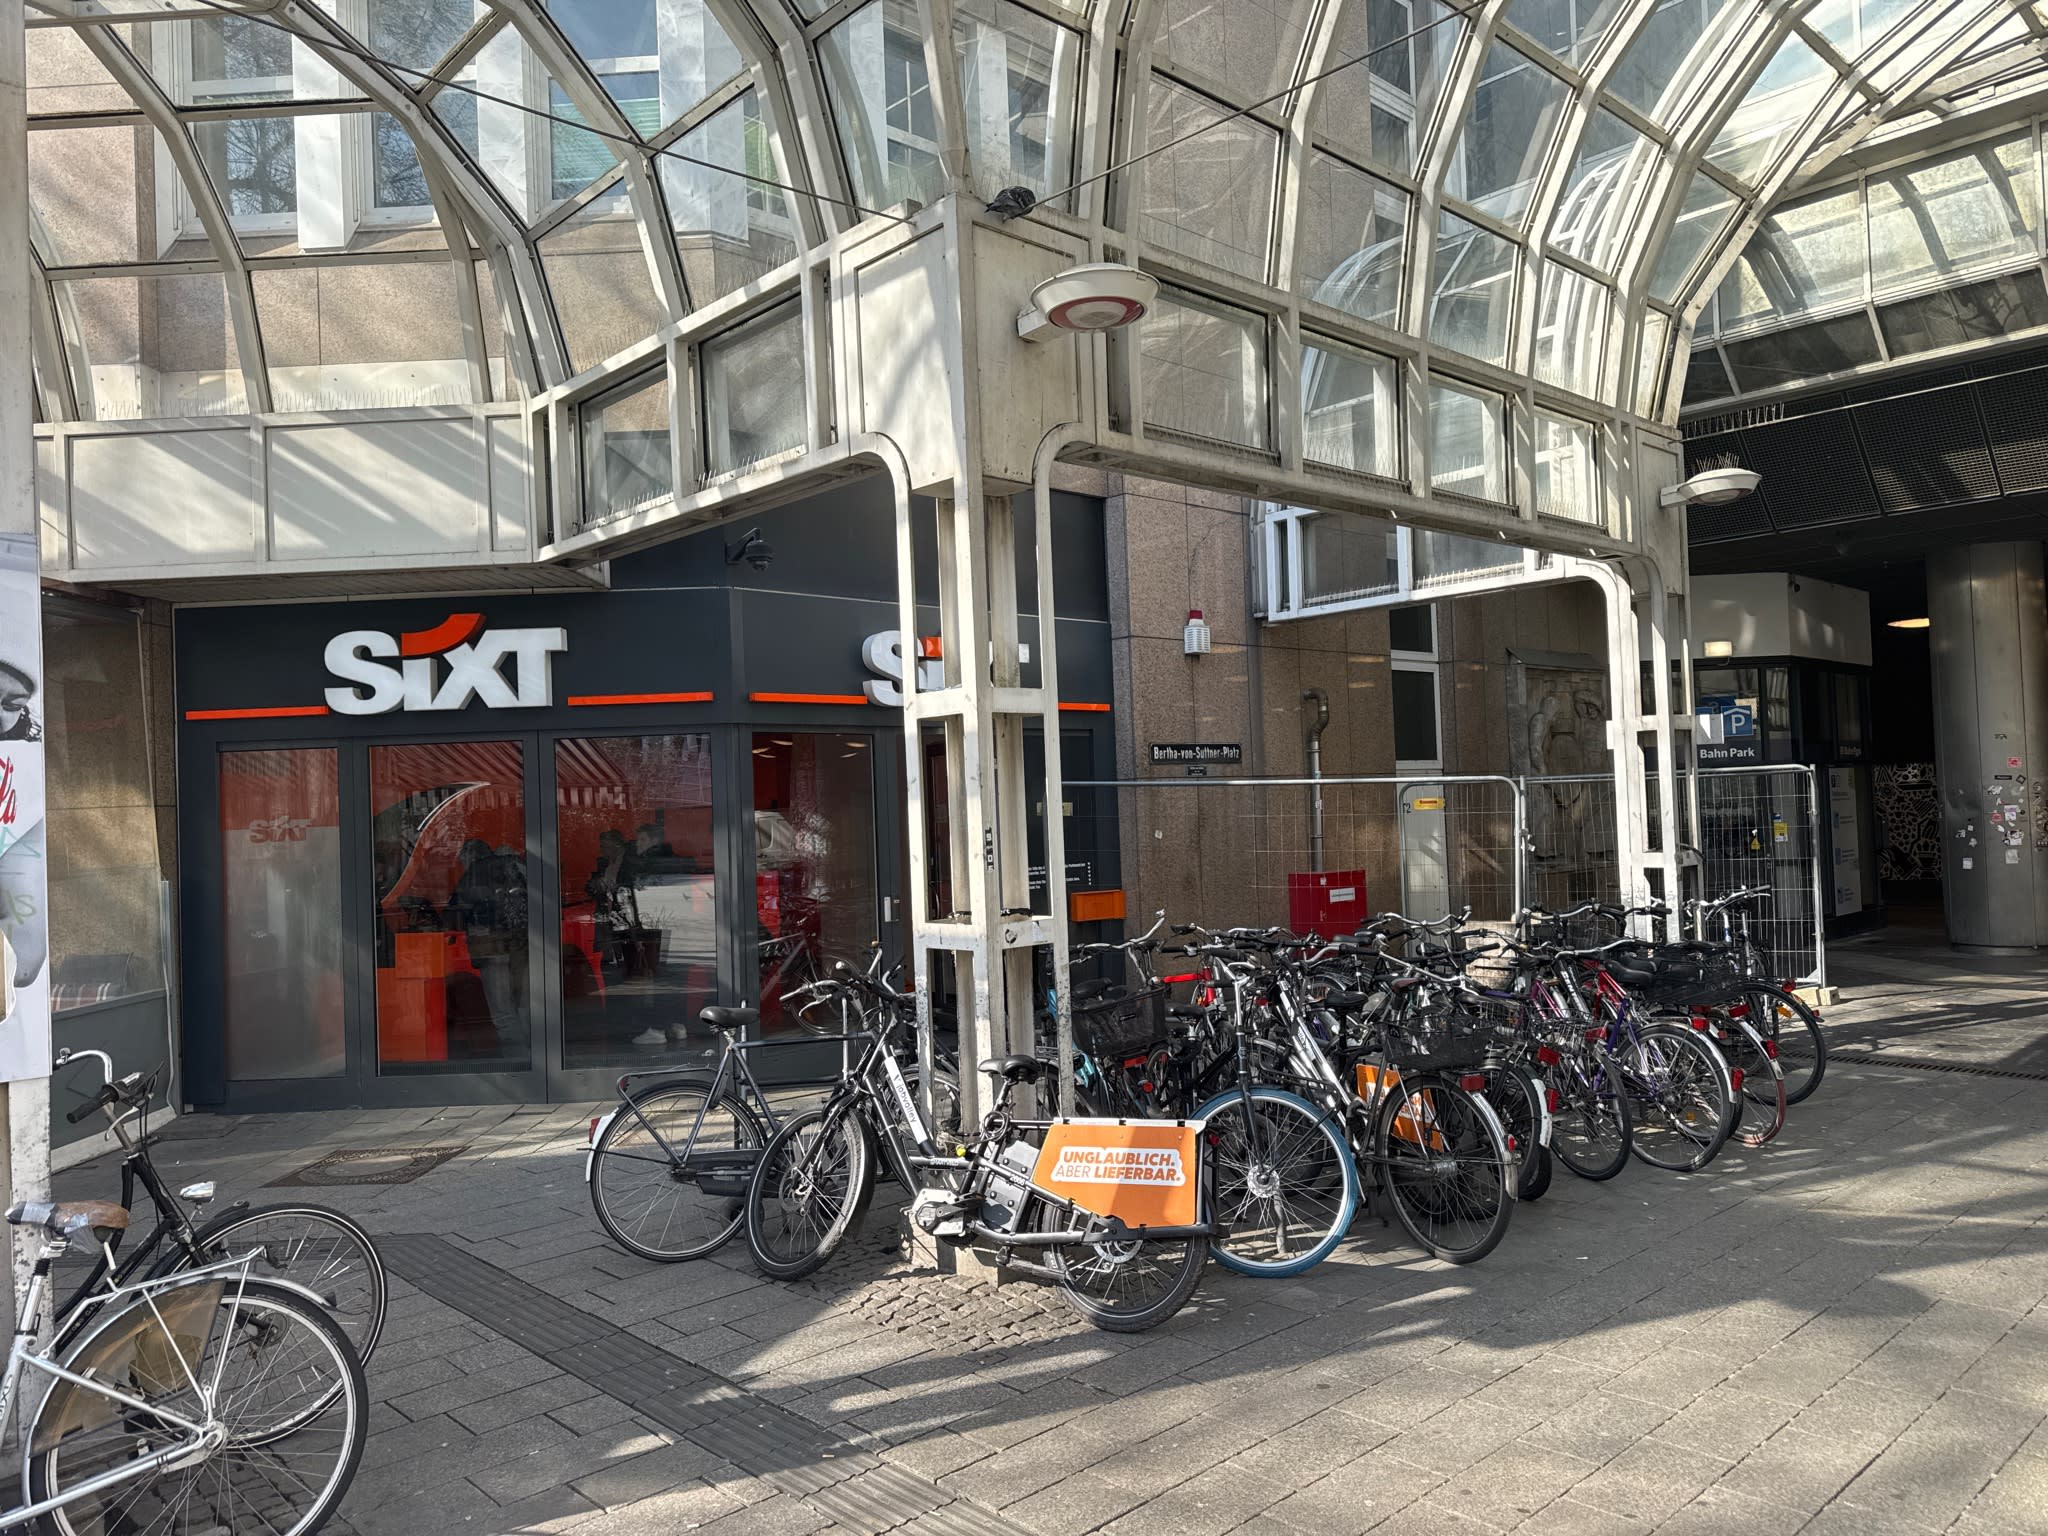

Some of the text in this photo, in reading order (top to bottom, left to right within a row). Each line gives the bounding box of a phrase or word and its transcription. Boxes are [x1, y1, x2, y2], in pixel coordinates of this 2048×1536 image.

[1153, 746, 1240, 760] Bertha-von-Suttner-Platz
[1700, 747, 1755, 759] Bahn Park
[895, 1084, 917, 1123] jobvalley
[1063, 1151, 1176, 1167] UNGLAUBLICH.
[1055, 1165, 1182, 1181] ABER LIEFERBAR.
